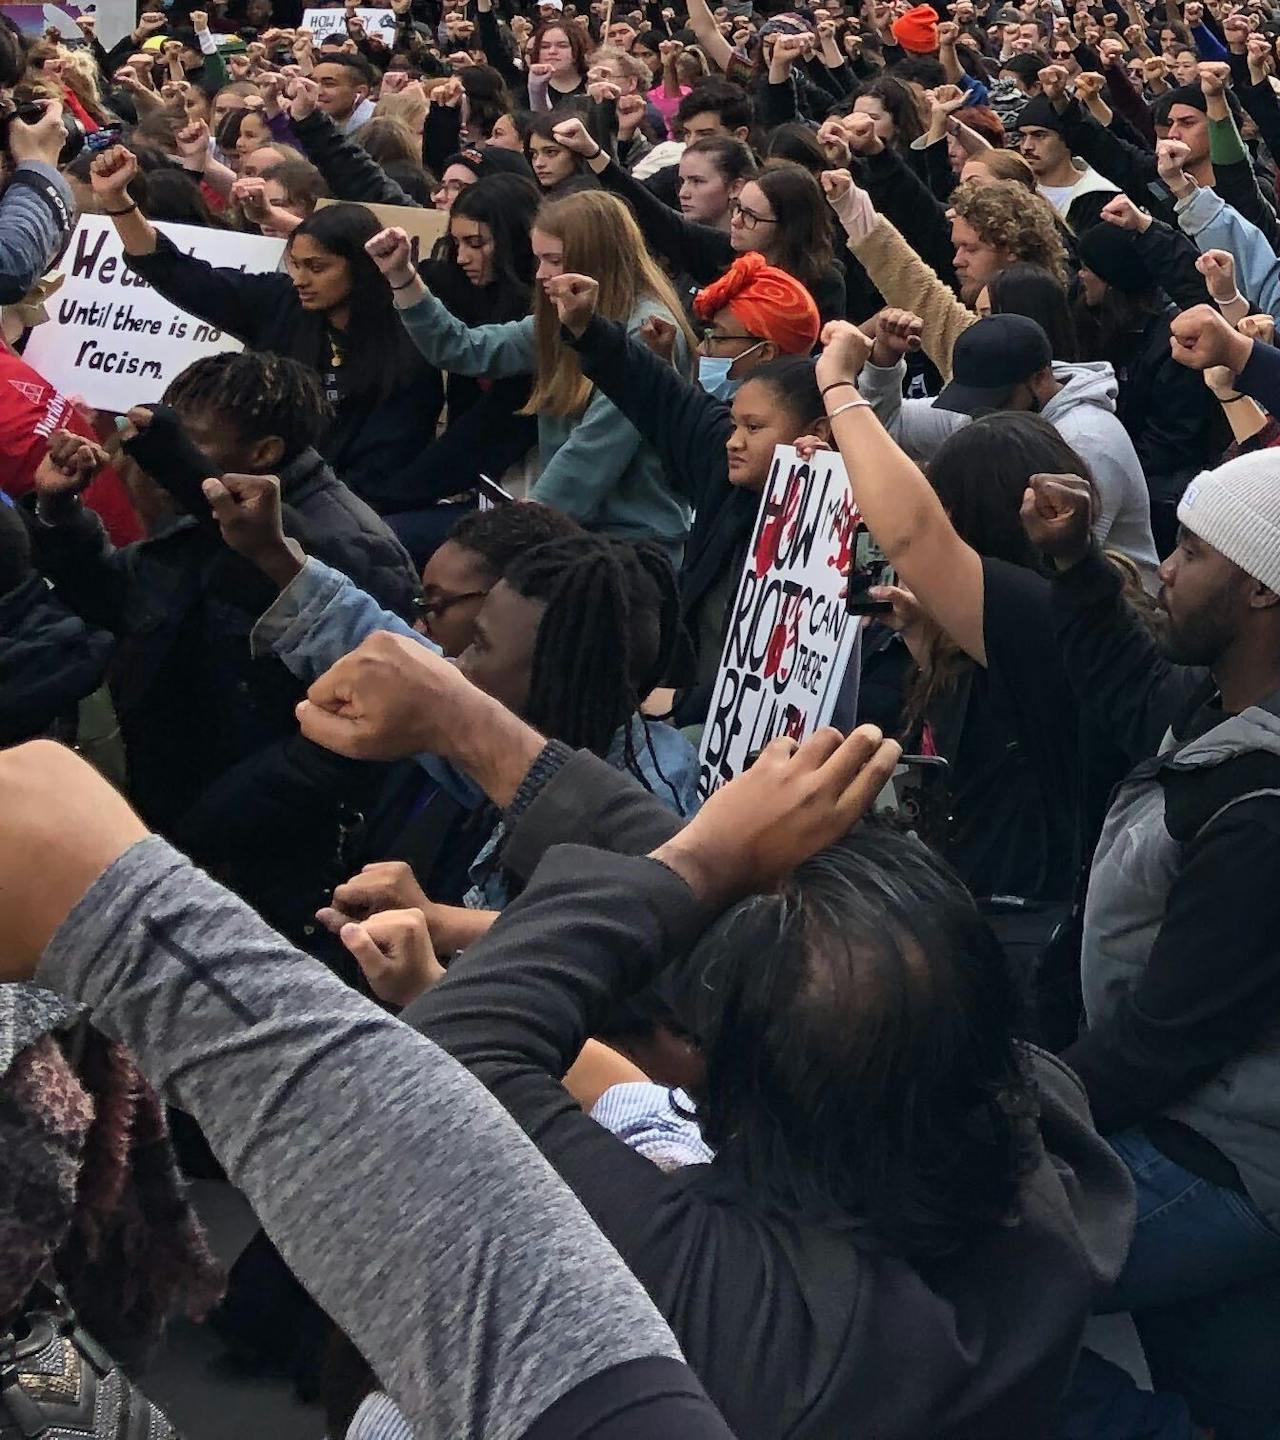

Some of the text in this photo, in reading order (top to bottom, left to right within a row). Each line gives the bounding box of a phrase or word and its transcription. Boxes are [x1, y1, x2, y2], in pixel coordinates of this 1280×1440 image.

[310, 15, 335, 27] HOW
[71, 228, 117, 284] We
[58, 298, 222, 342] Until there is no
[74, 339, 163, 380] racism.
[753, 459, 832, 570] HOW
[723, 572, 849, 695] RIOTS CAN
[795, 643, 829, 695] THERE
[706, 669, 762, 781] BE
